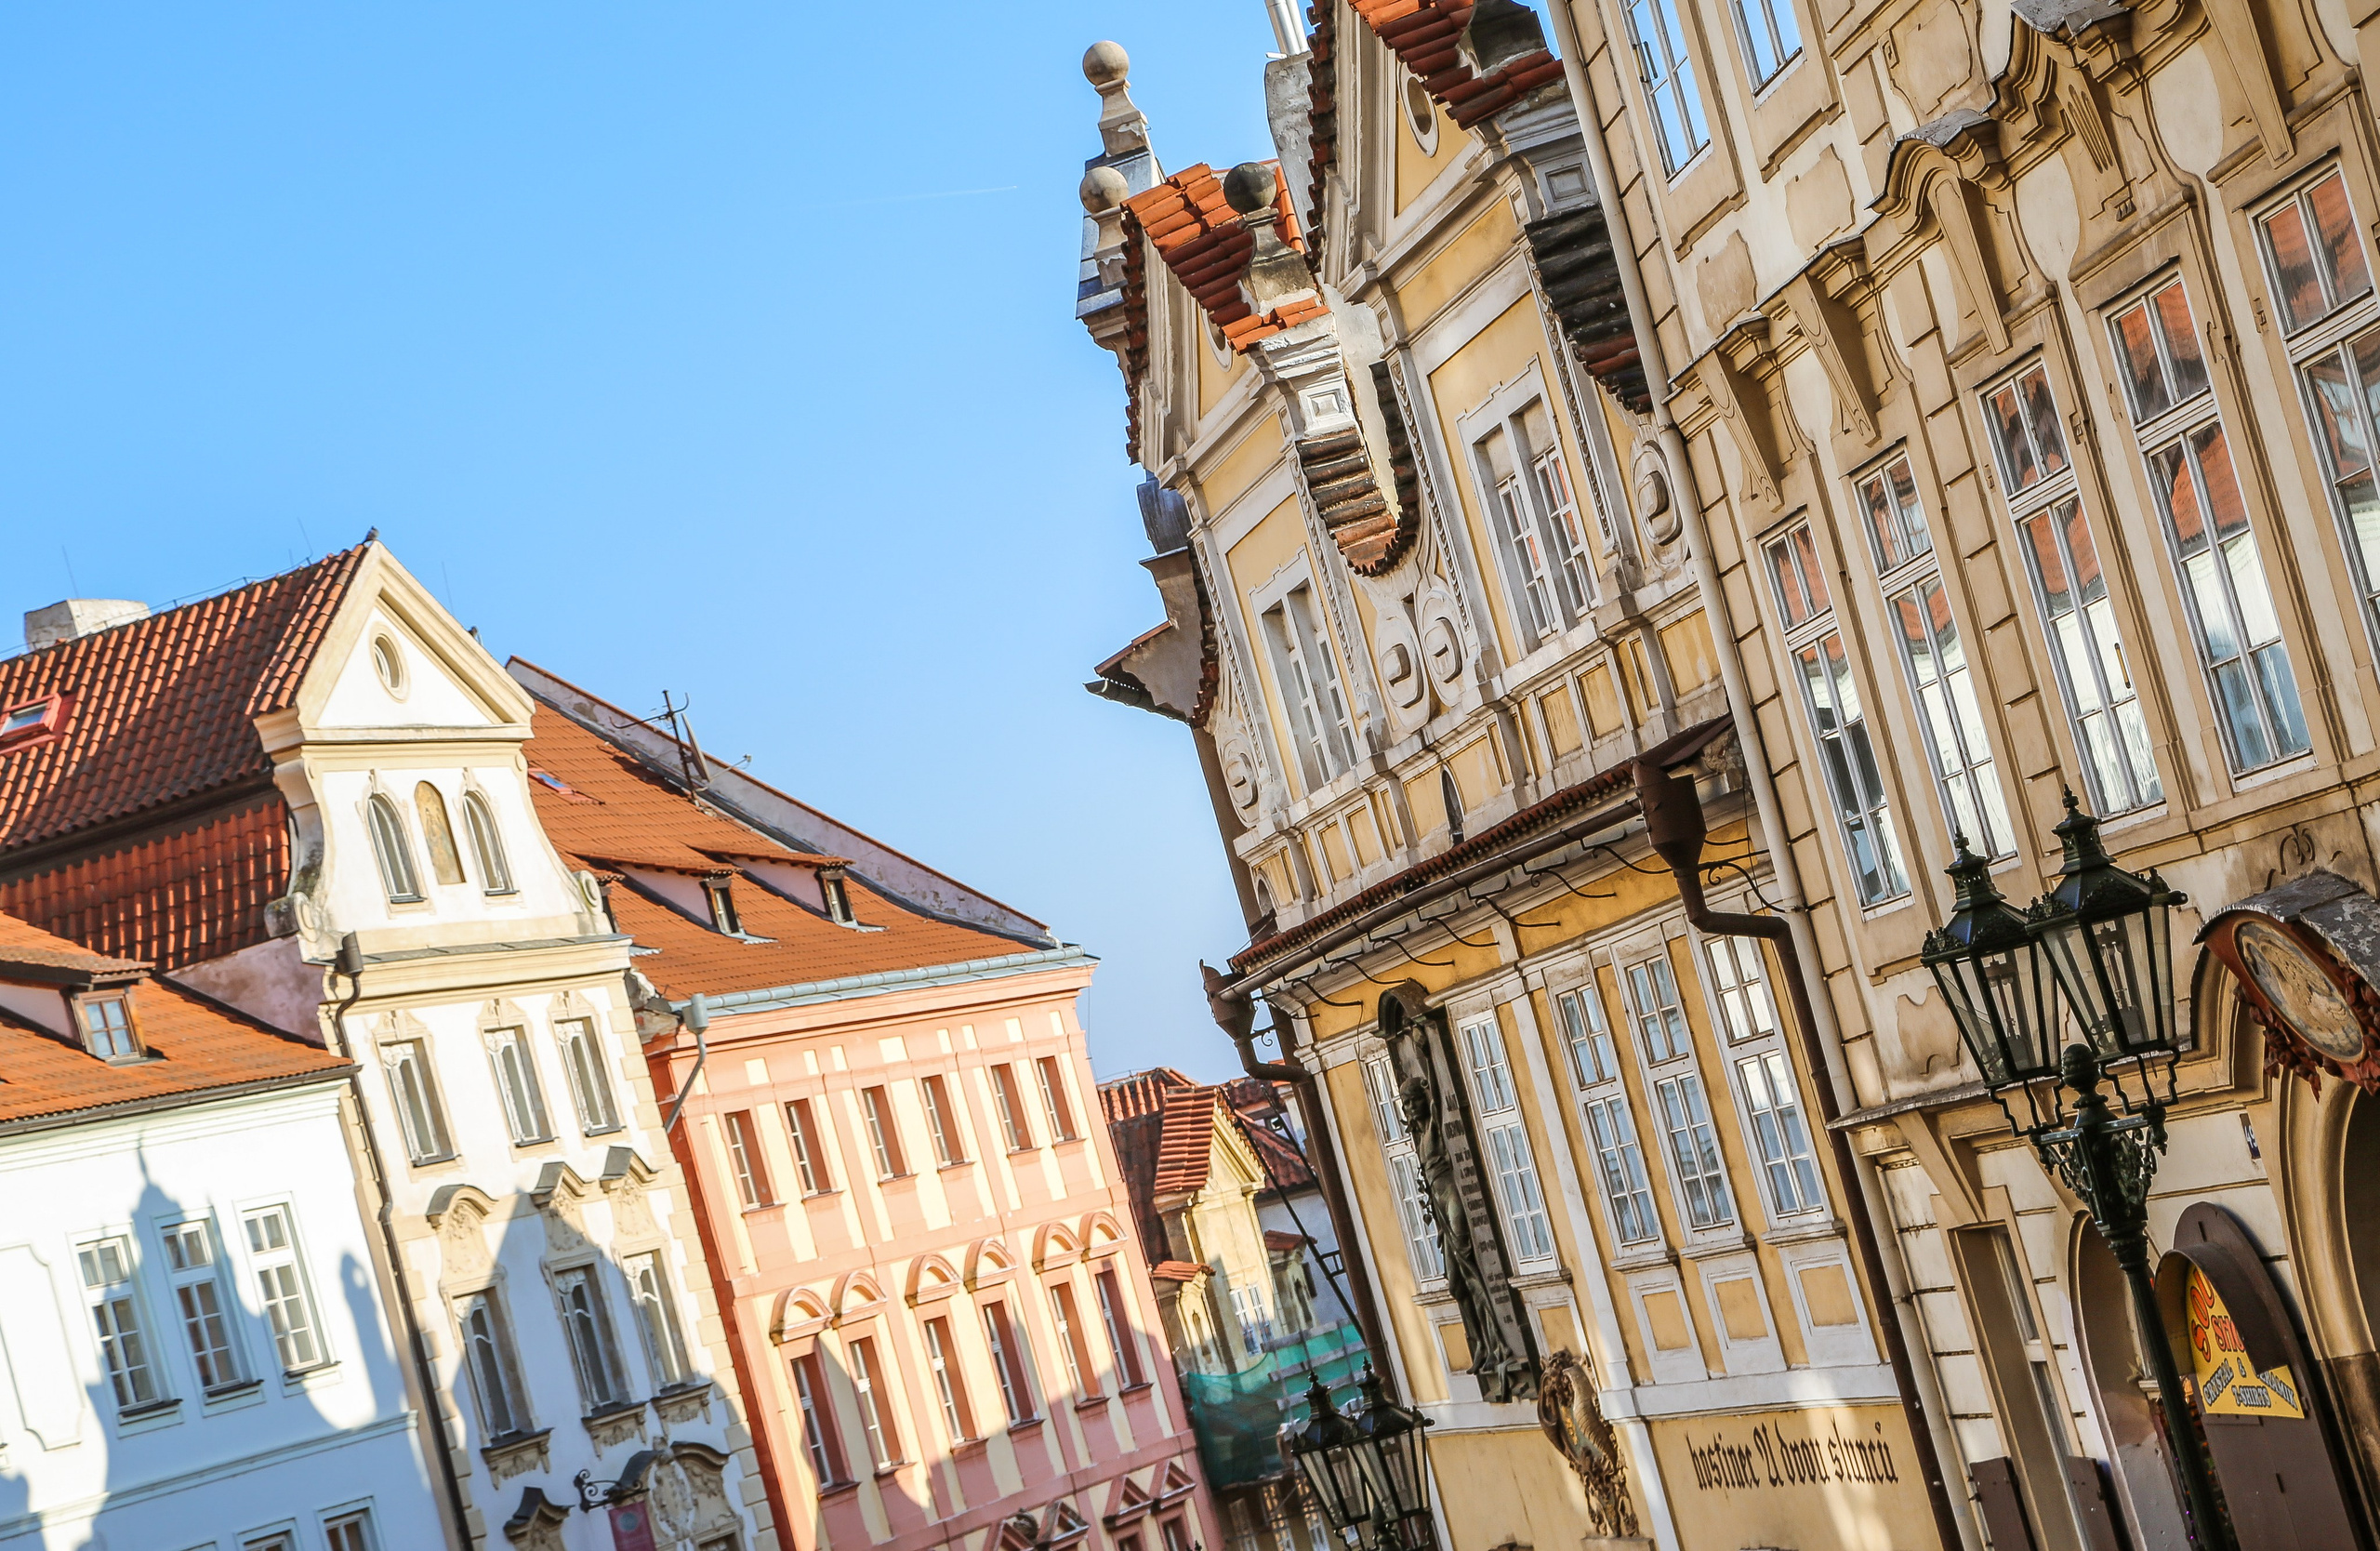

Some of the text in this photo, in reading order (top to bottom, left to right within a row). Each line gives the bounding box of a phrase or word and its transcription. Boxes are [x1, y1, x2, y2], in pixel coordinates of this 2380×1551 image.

[2202, 1357, 2298, 1412] CRYSTAL & ERAMIK
[2231, 1385, 2271, 1408] T-SHIRTS
[1752, 1422, 1784, 1488] U
